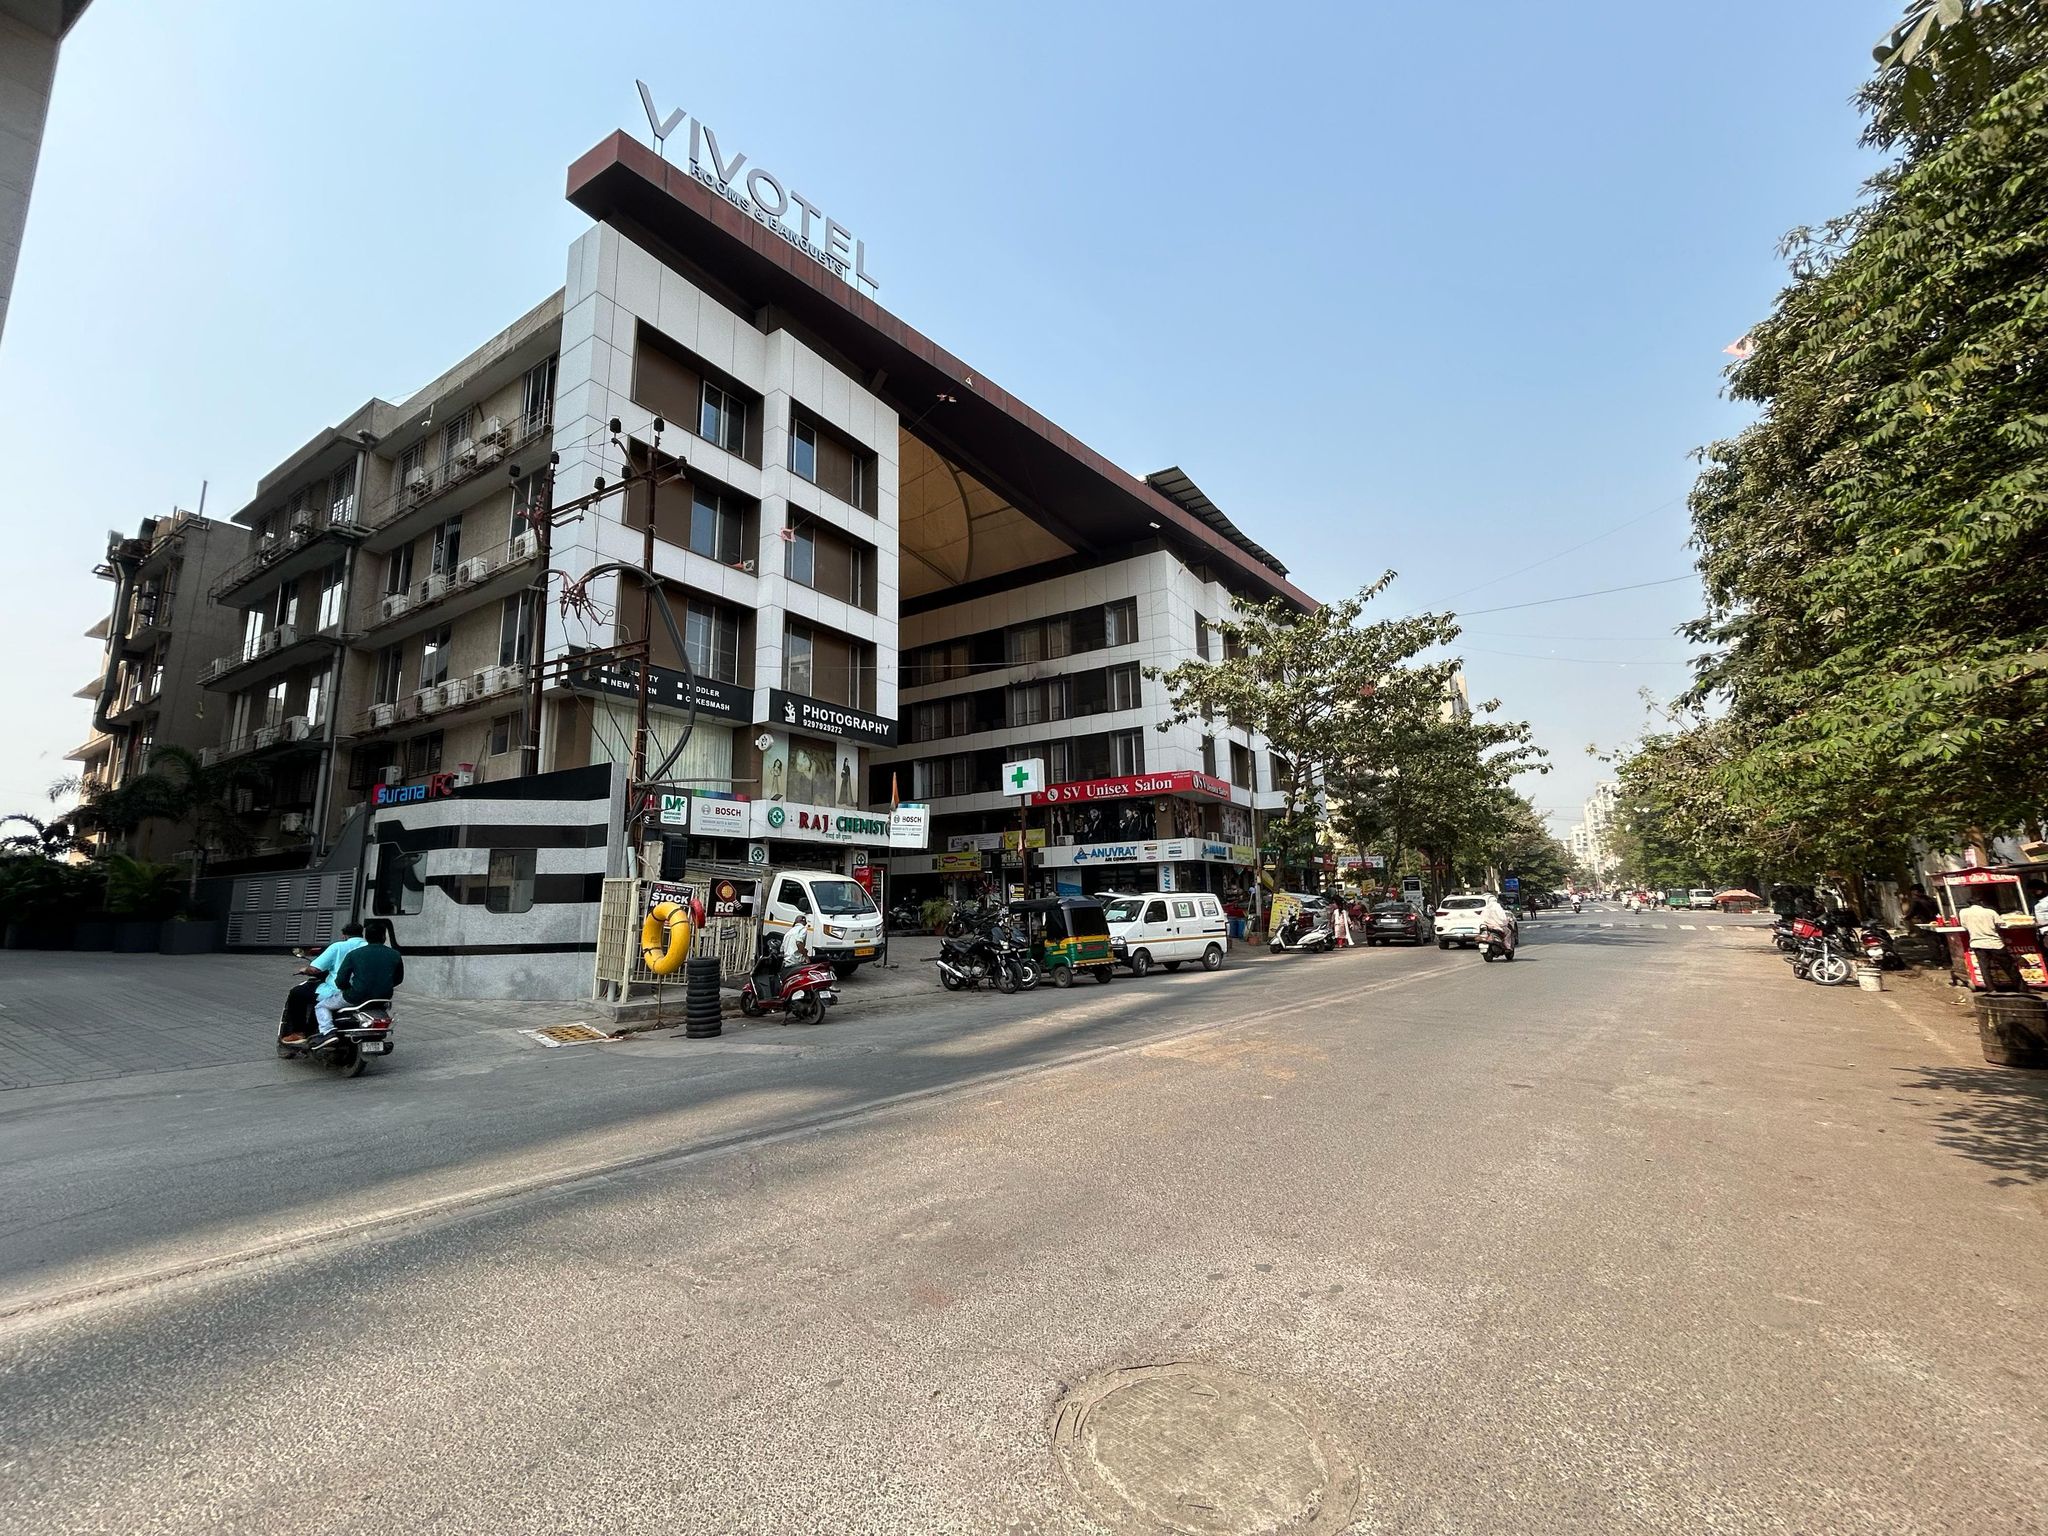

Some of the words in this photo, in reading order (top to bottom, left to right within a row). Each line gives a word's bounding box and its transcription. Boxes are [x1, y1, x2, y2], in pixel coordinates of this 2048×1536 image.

[636, 78, 879, 290] VIVOTEL
[690, 162, 750, 211] ROOMS
[754, 208, 765, 223] &
[769, 216, 843, 275] BANQUETS
[610, 679, 630, 690] NEW
[634, 684, 657, 696] BRN
[686, 683, 720, 698] TDDLER
[685, 695, 730, 711] CKESMASH
[803, 704, 889, 735] PHOTOGRAPHY
[1063, 786, 1081, 799] SV
[1086, 783, 1129, 797] Unisex
[1135, 778, 1172, 792] Salon
[715, 807, 741, 816] BOSCH
[799, 811, 829, 833] RAJ
[836, 815, 886, 837] CHEMIST
[1090, 846, 1137, 858] ANUVRAT
[651, 892, 689, 904] STOCK
[715, 901, 734, 913] RG
